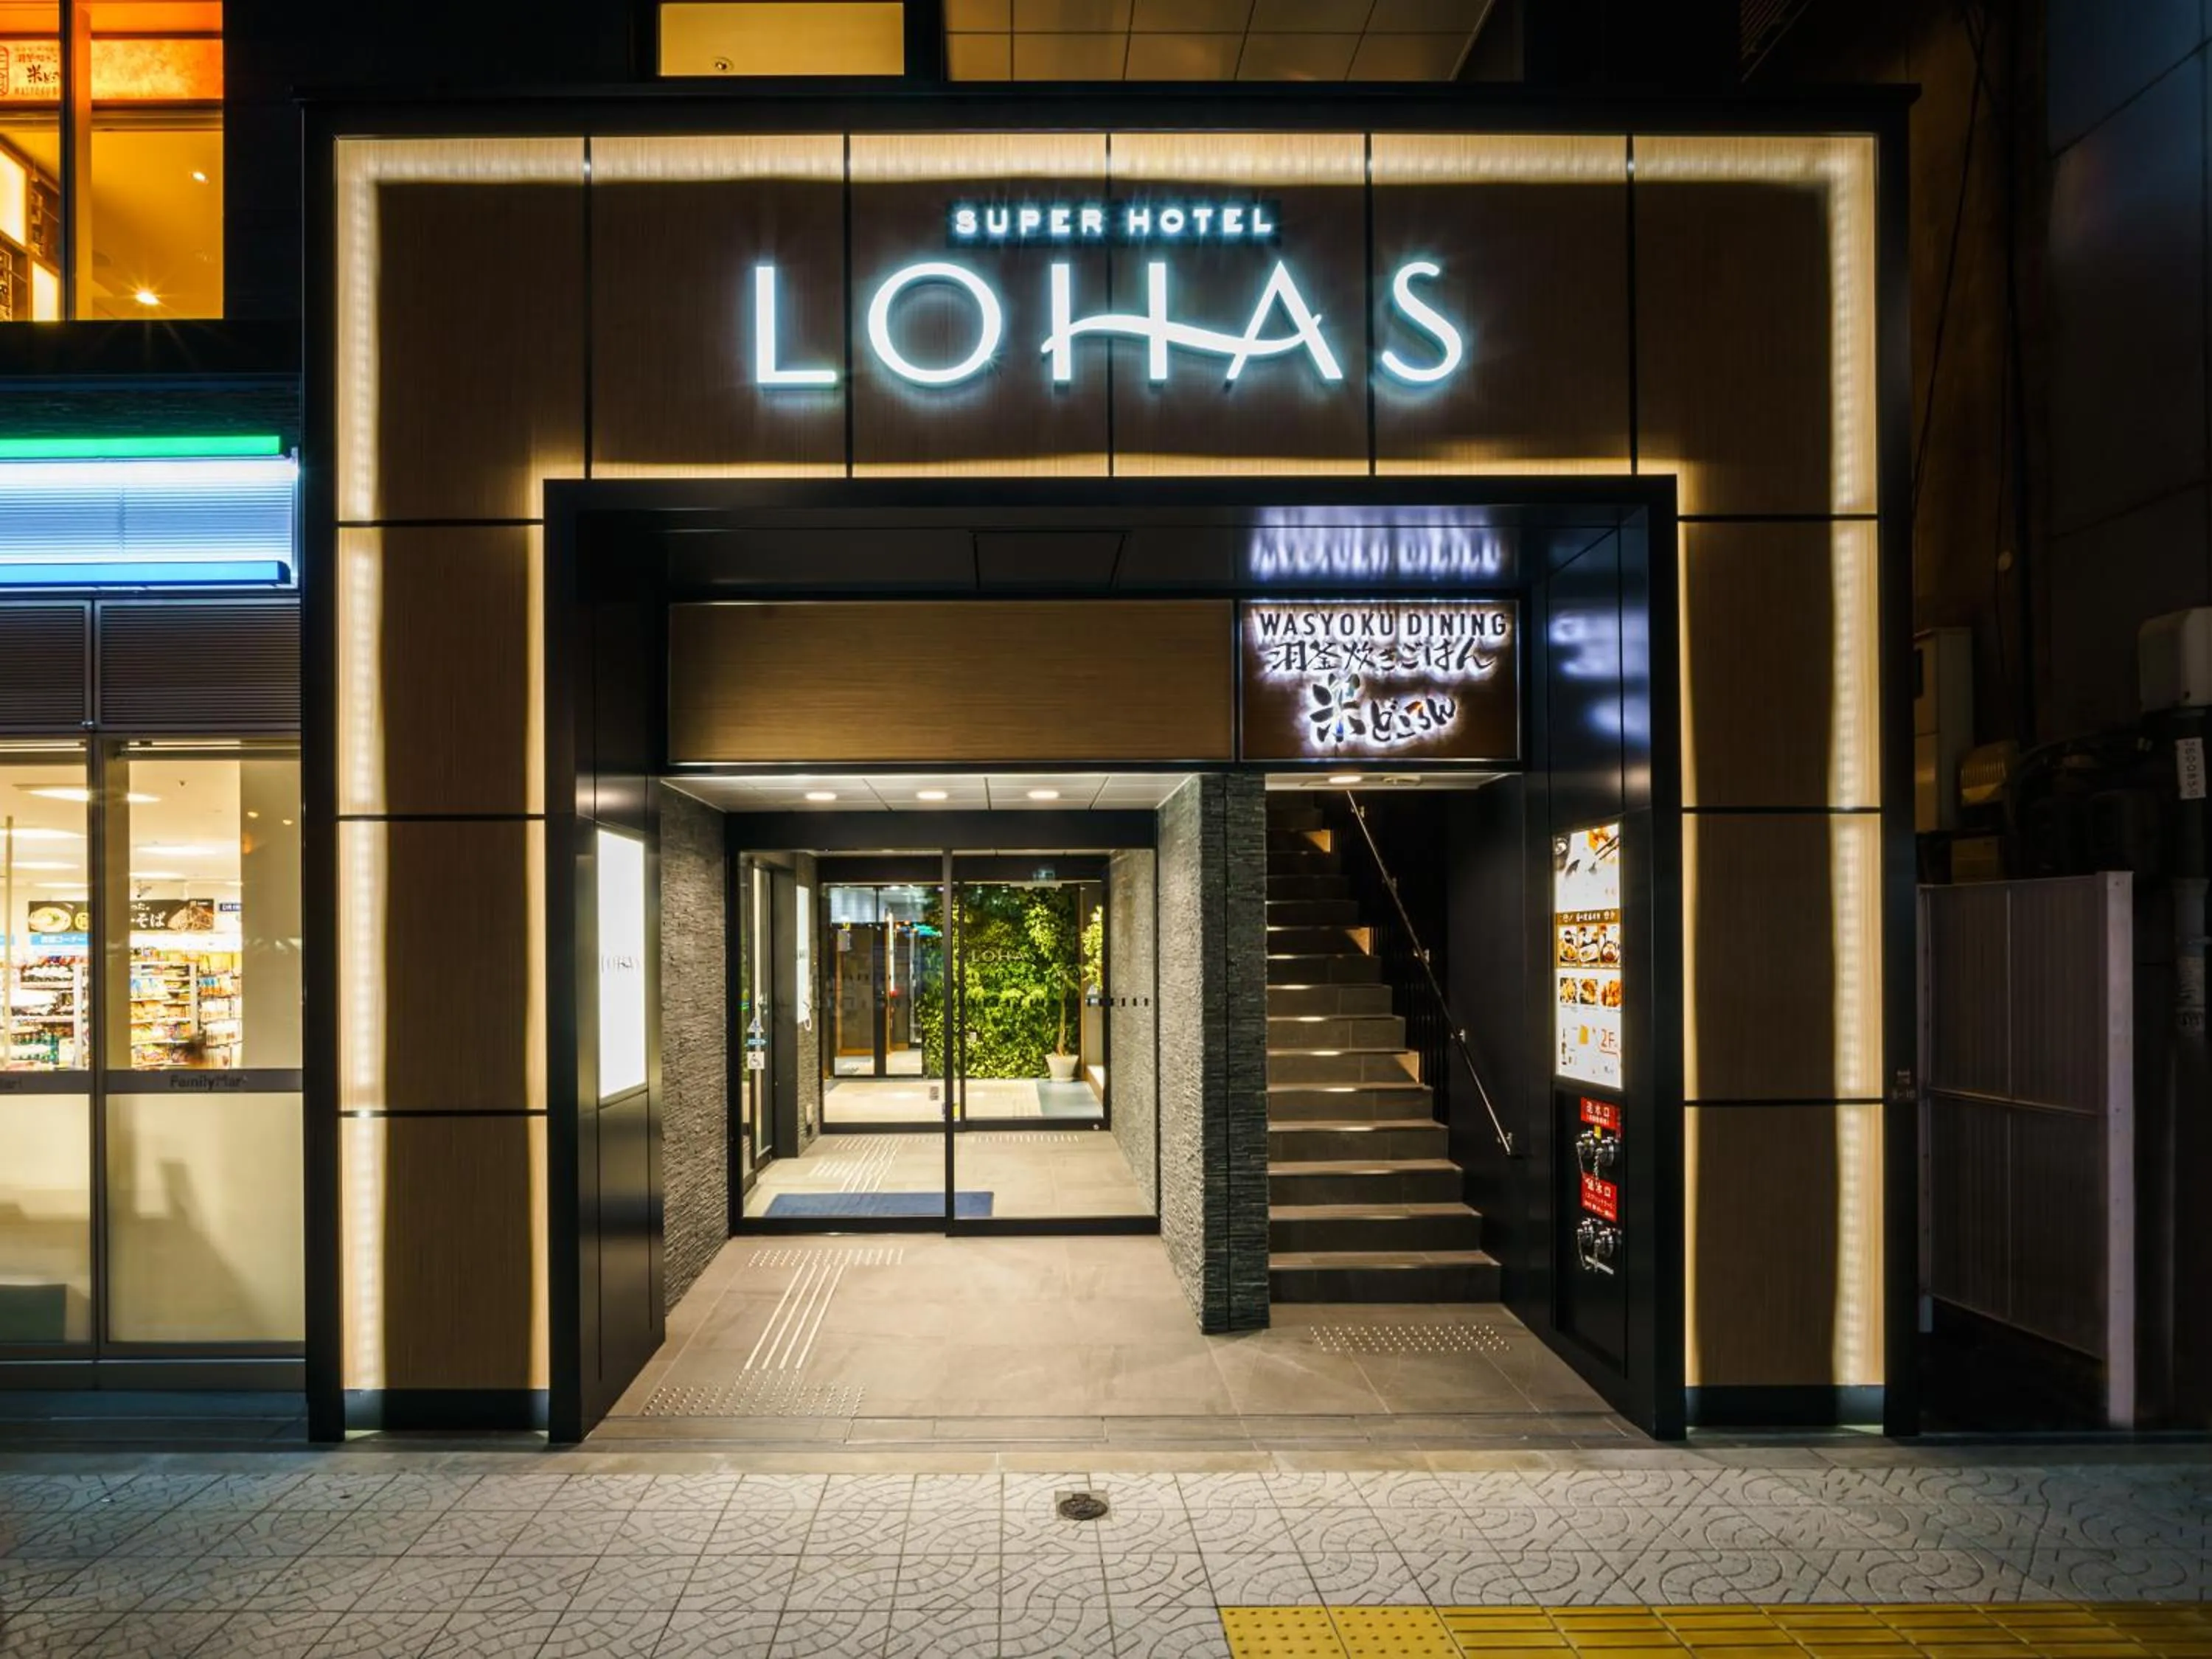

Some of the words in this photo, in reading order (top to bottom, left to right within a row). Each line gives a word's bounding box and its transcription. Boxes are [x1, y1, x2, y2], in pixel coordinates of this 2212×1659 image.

[953, 206, 1104, 235] SUPER
[1128, 206, 1273, 235] HOTEL
[754, 260, 1463, 385] LOHAS
[1259, 613, 1394, 636] WASYOKU
[1407, 613, 1506, 636] DINING
[1270, 636, 1496, 672] 羽釜炊きごはん
